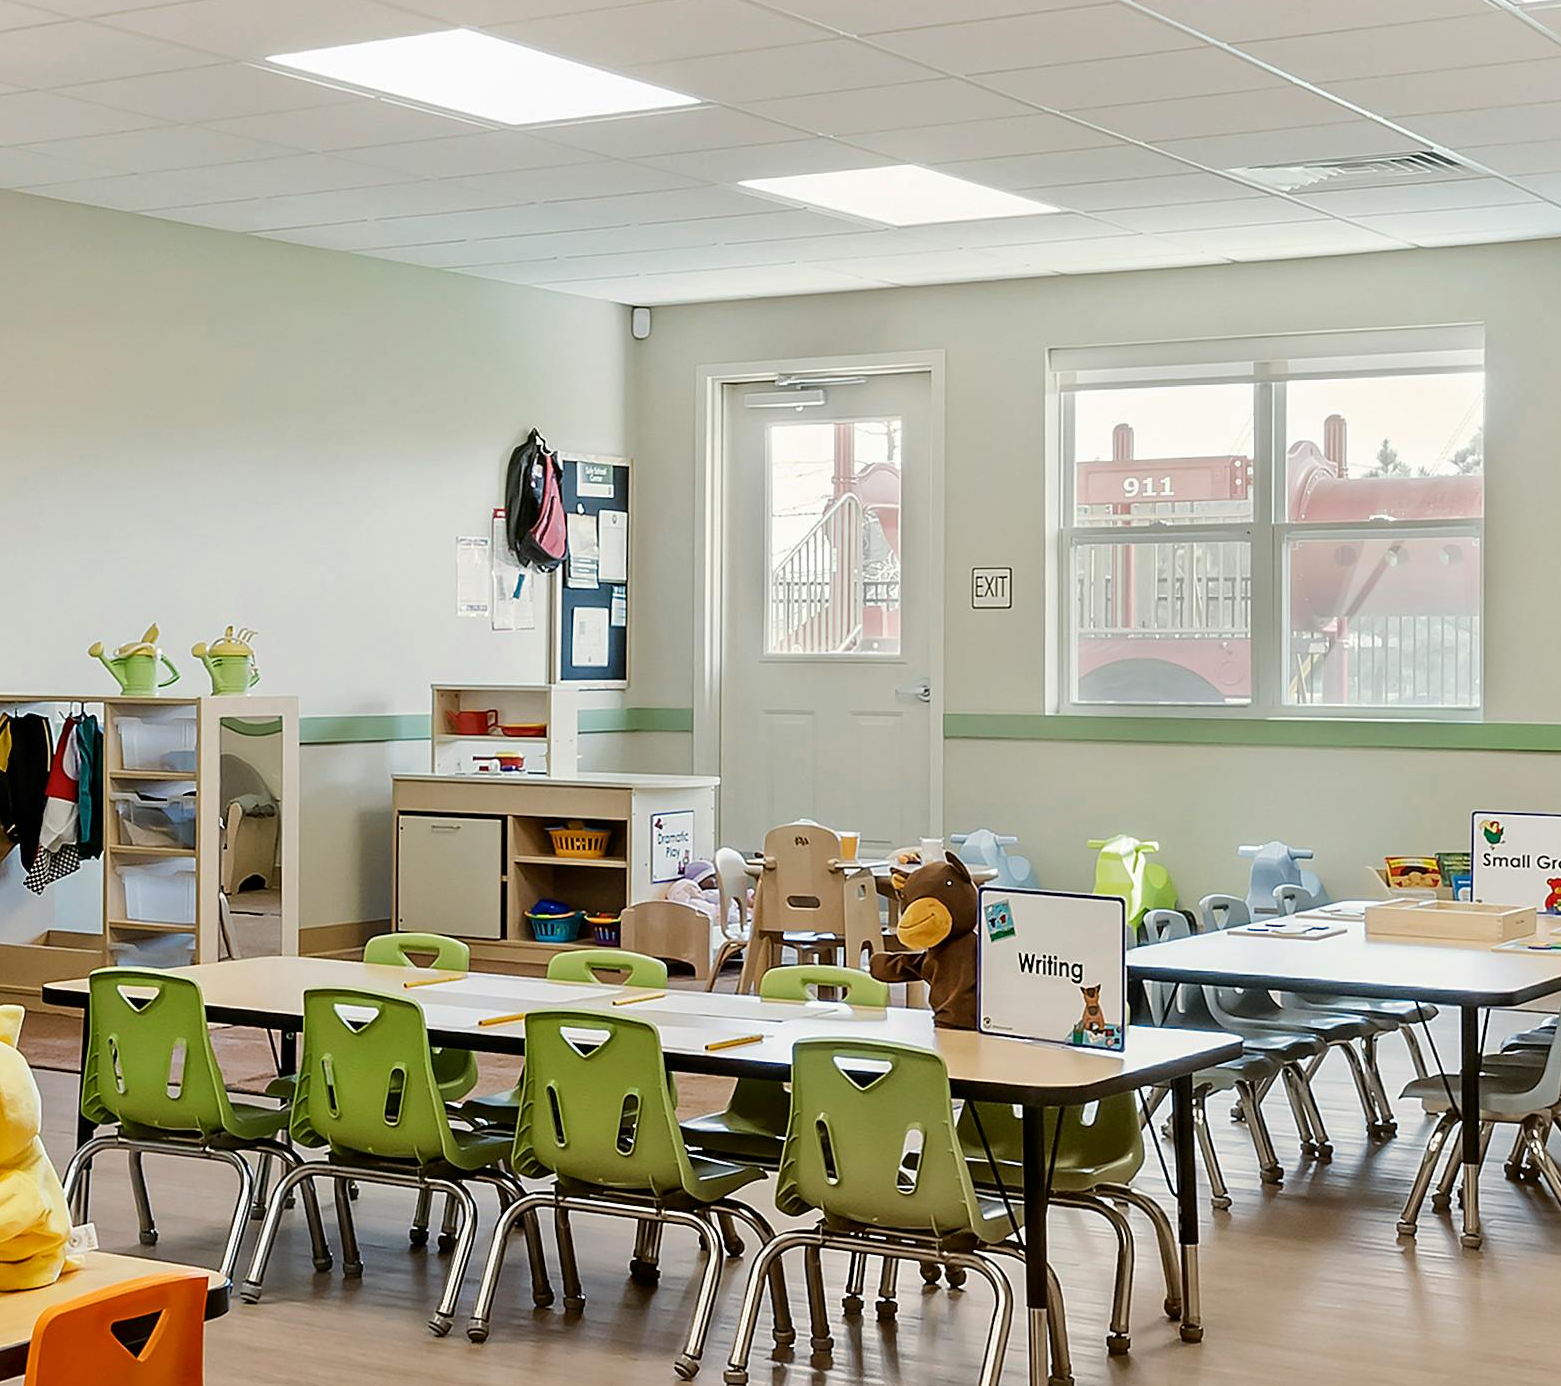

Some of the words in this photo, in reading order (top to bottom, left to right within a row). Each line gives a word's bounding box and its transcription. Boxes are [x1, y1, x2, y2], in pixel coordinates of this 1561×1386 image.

[1123, 476, 1175, 498] 911
[975, 575, 1008, 598] EXIT
[658, 831, 688, 845] Dramatic
[666, 846, 681, 860] Play
[1482, 853, 1531, 869] Small
[1018, 952, 1084, 984] Writing
